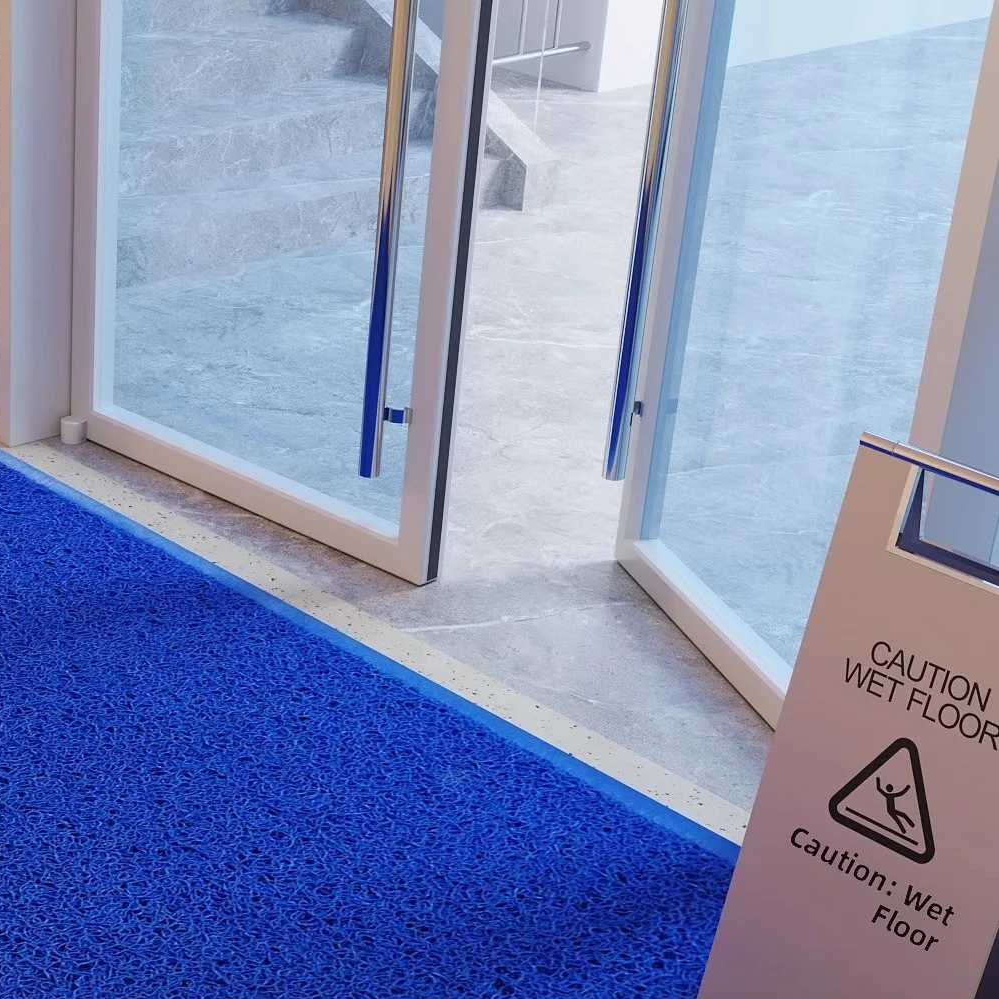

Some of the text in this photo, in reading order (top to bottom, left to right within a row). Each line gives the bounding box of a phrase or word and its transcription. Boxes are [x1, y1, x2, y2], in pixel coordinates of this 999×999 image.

[845, 657, 999, 751] WET FLOOR
[870, 641, 992, 713] CAUTION
[790, 827, 955, 927] Caution: Wet
[871, 904, 940, 952] Floor
